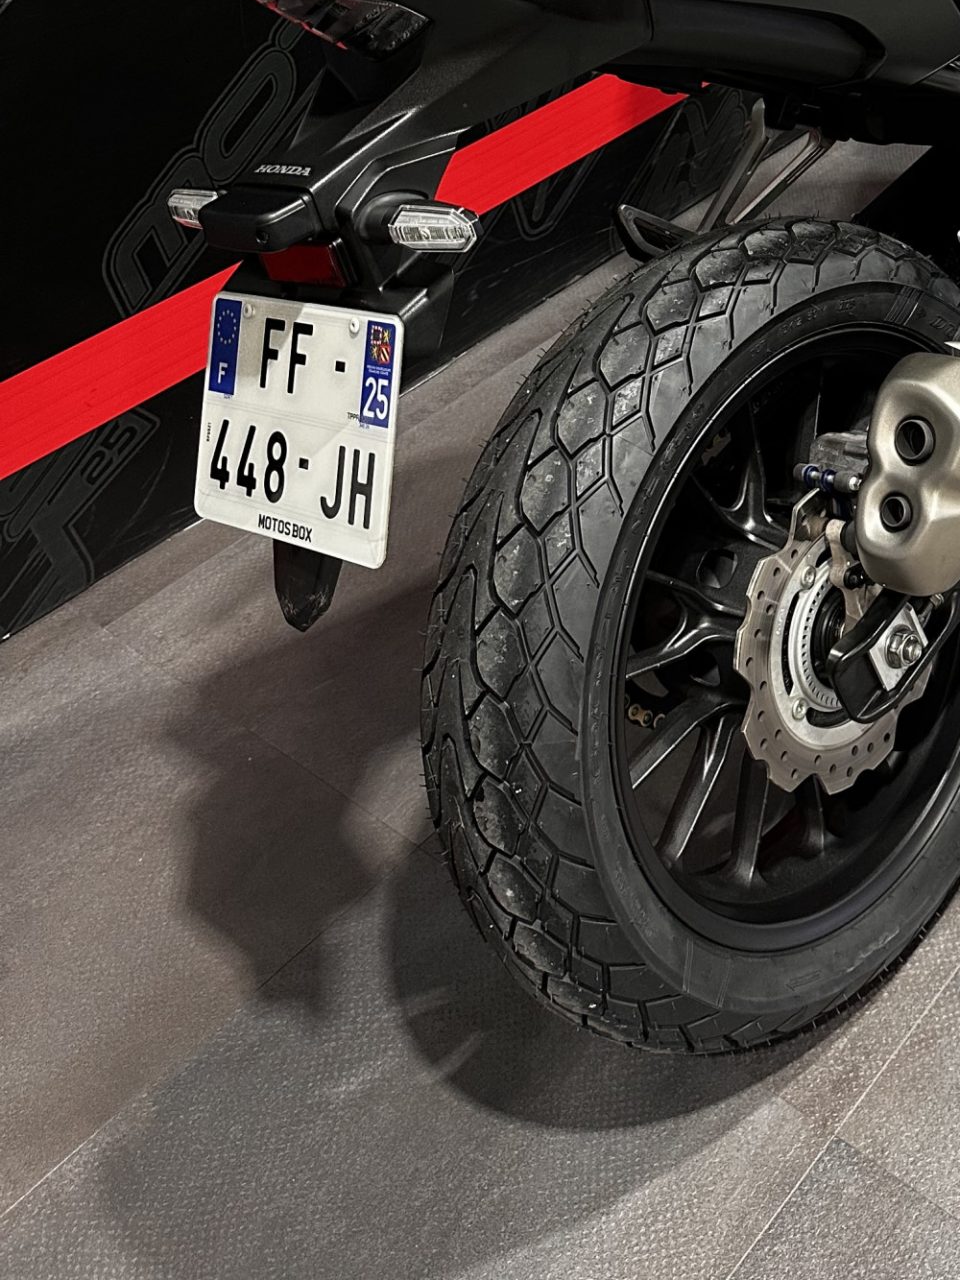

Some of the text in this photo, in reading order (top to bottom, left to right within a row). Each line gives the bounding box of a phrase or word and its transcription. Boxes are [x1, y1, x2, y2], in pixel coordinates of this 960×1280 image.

[254, 164, 311, 177] HONDA
[217, 362, 228, 384] F
[362, 376, 389, 420] 25
